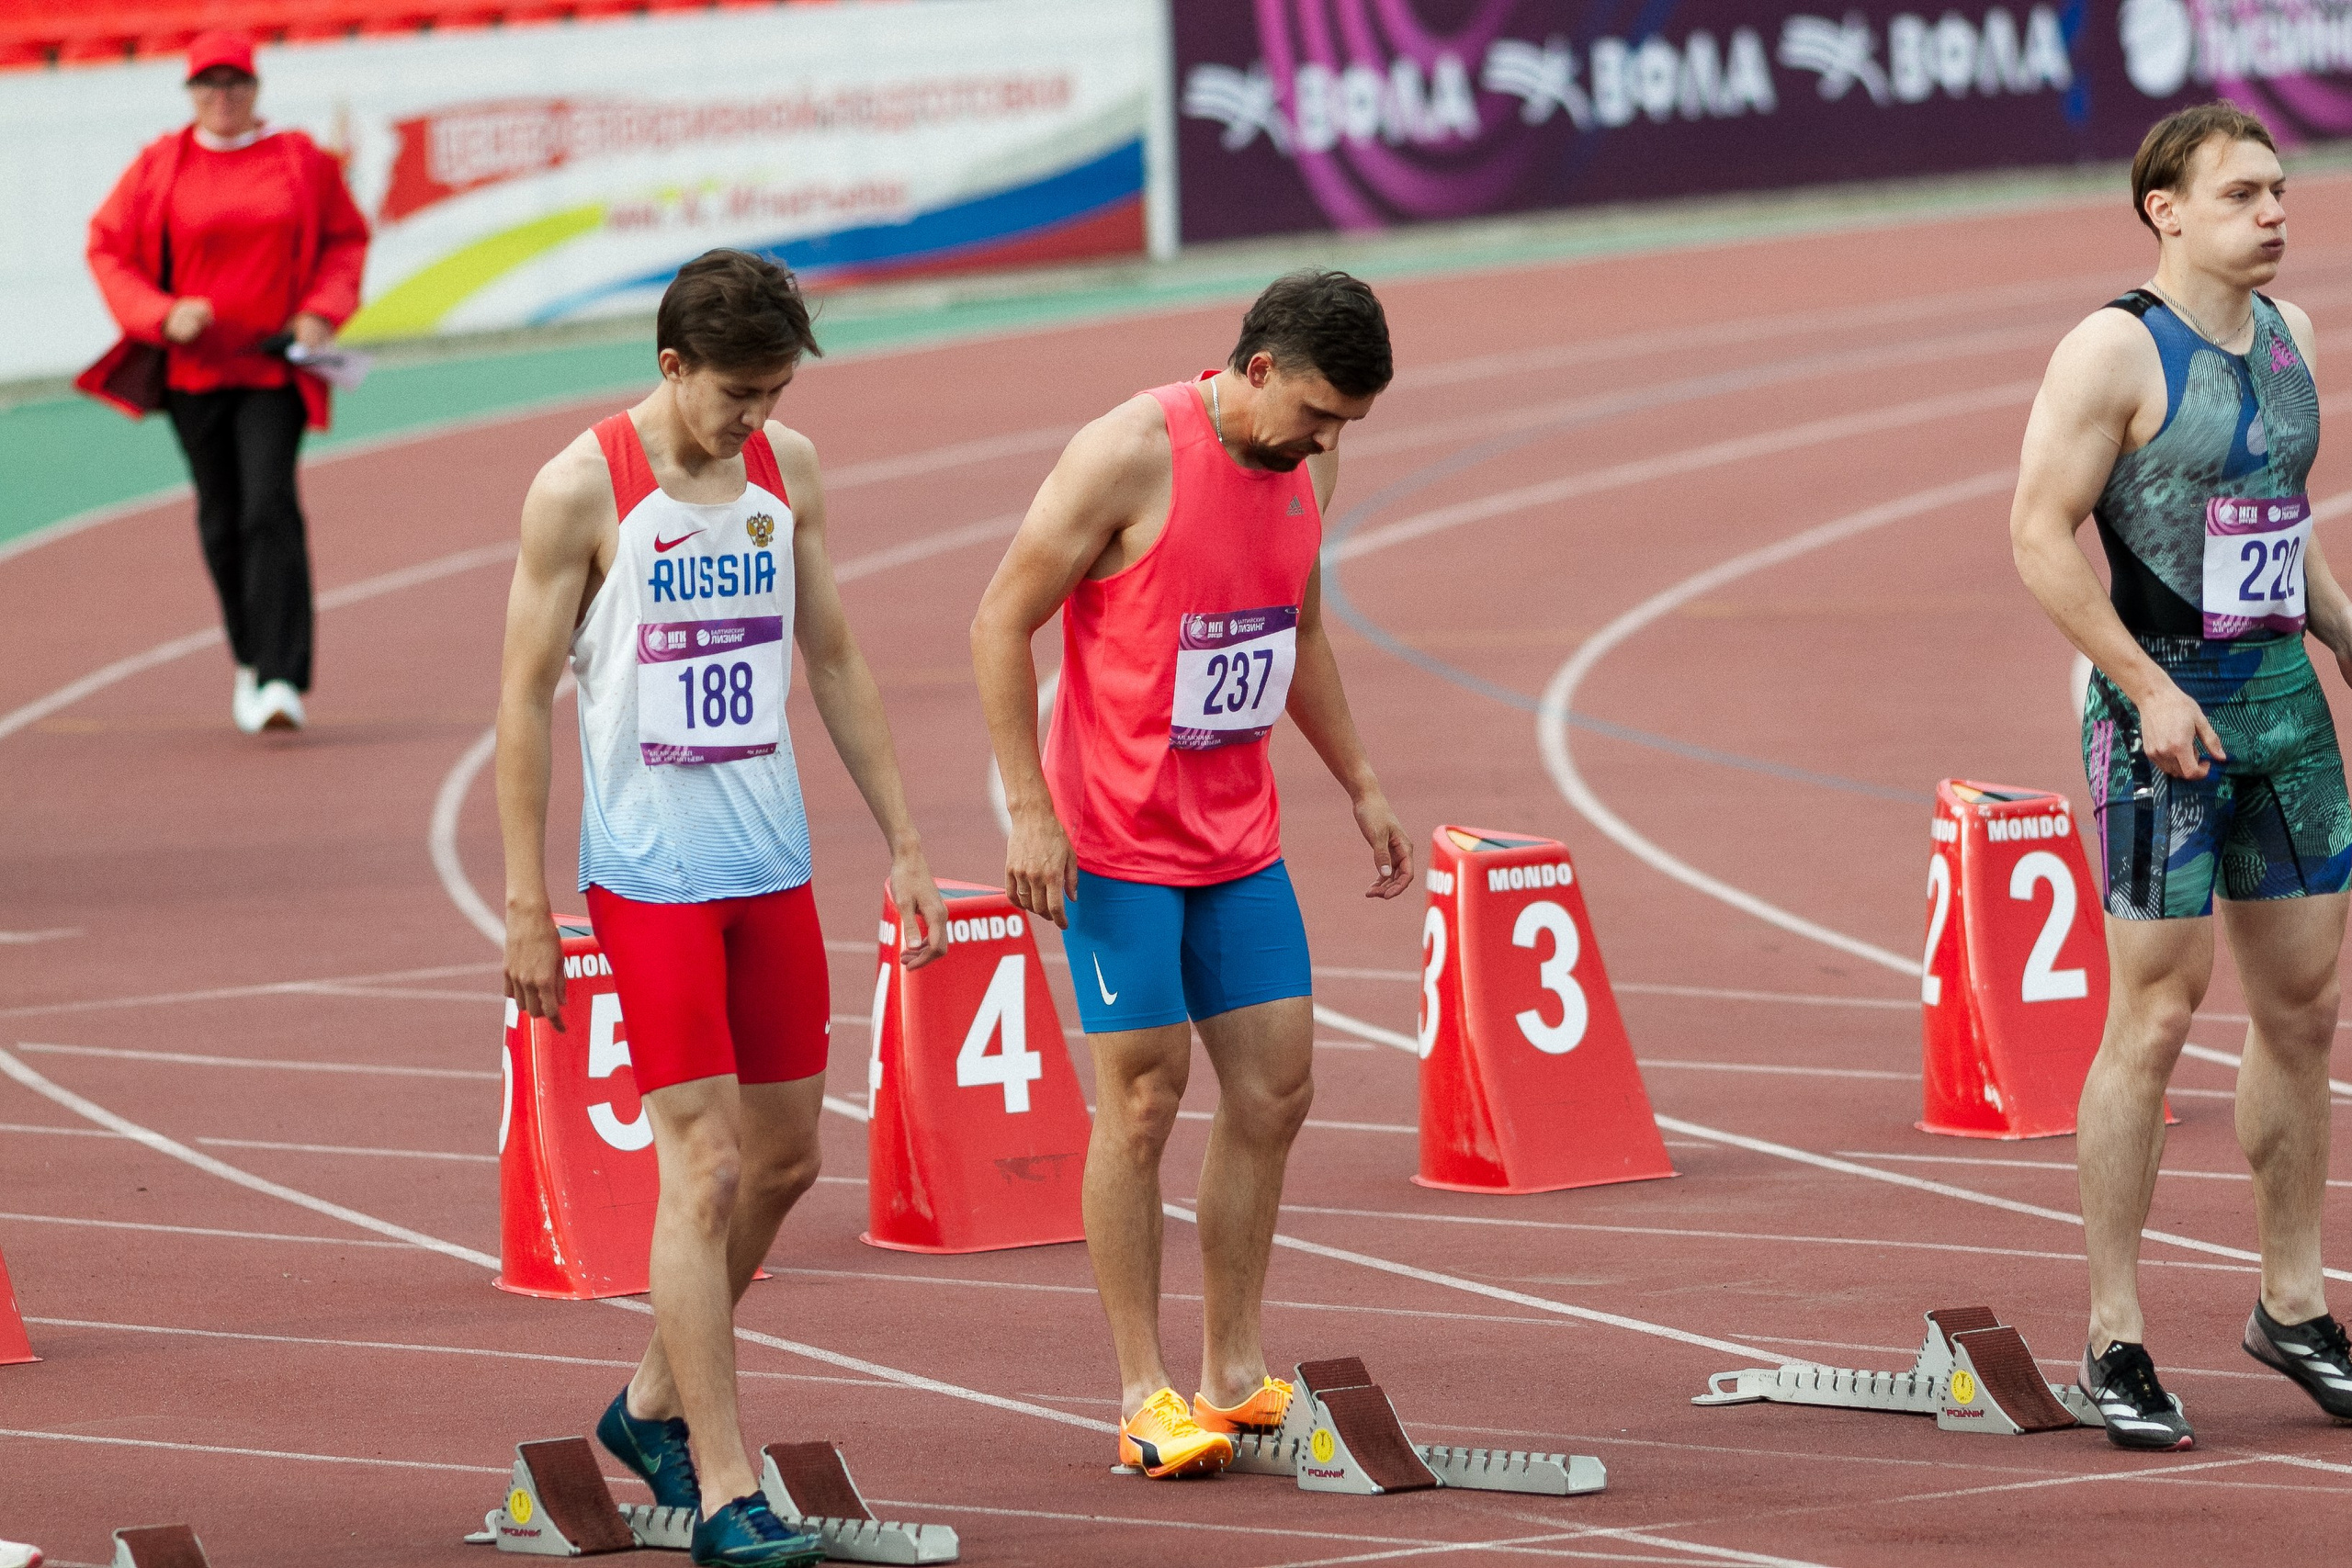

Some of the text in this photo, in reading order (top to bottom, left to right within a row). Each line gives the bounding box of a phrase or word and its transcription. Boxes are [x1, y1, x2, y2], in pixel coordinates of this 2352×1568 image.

[648, 551, 776, 603] RUSSIA
[678, 661, 753, 729] 188
[1204, 649, 1273, 716] 237
[1487, 863, 1573, 892] MONDO
[1987, 815, 2069, 842] MONDO
[1418, 906, 1447, 1059] 3
[1512, 900, 1589, 1055] 3
[1921, 852, 1951, 1007] 2
[2009, 851, 2088, 1003] 2
[586, 992, 655, 1152] 5
[956, 953, 1042, 1113] 4
